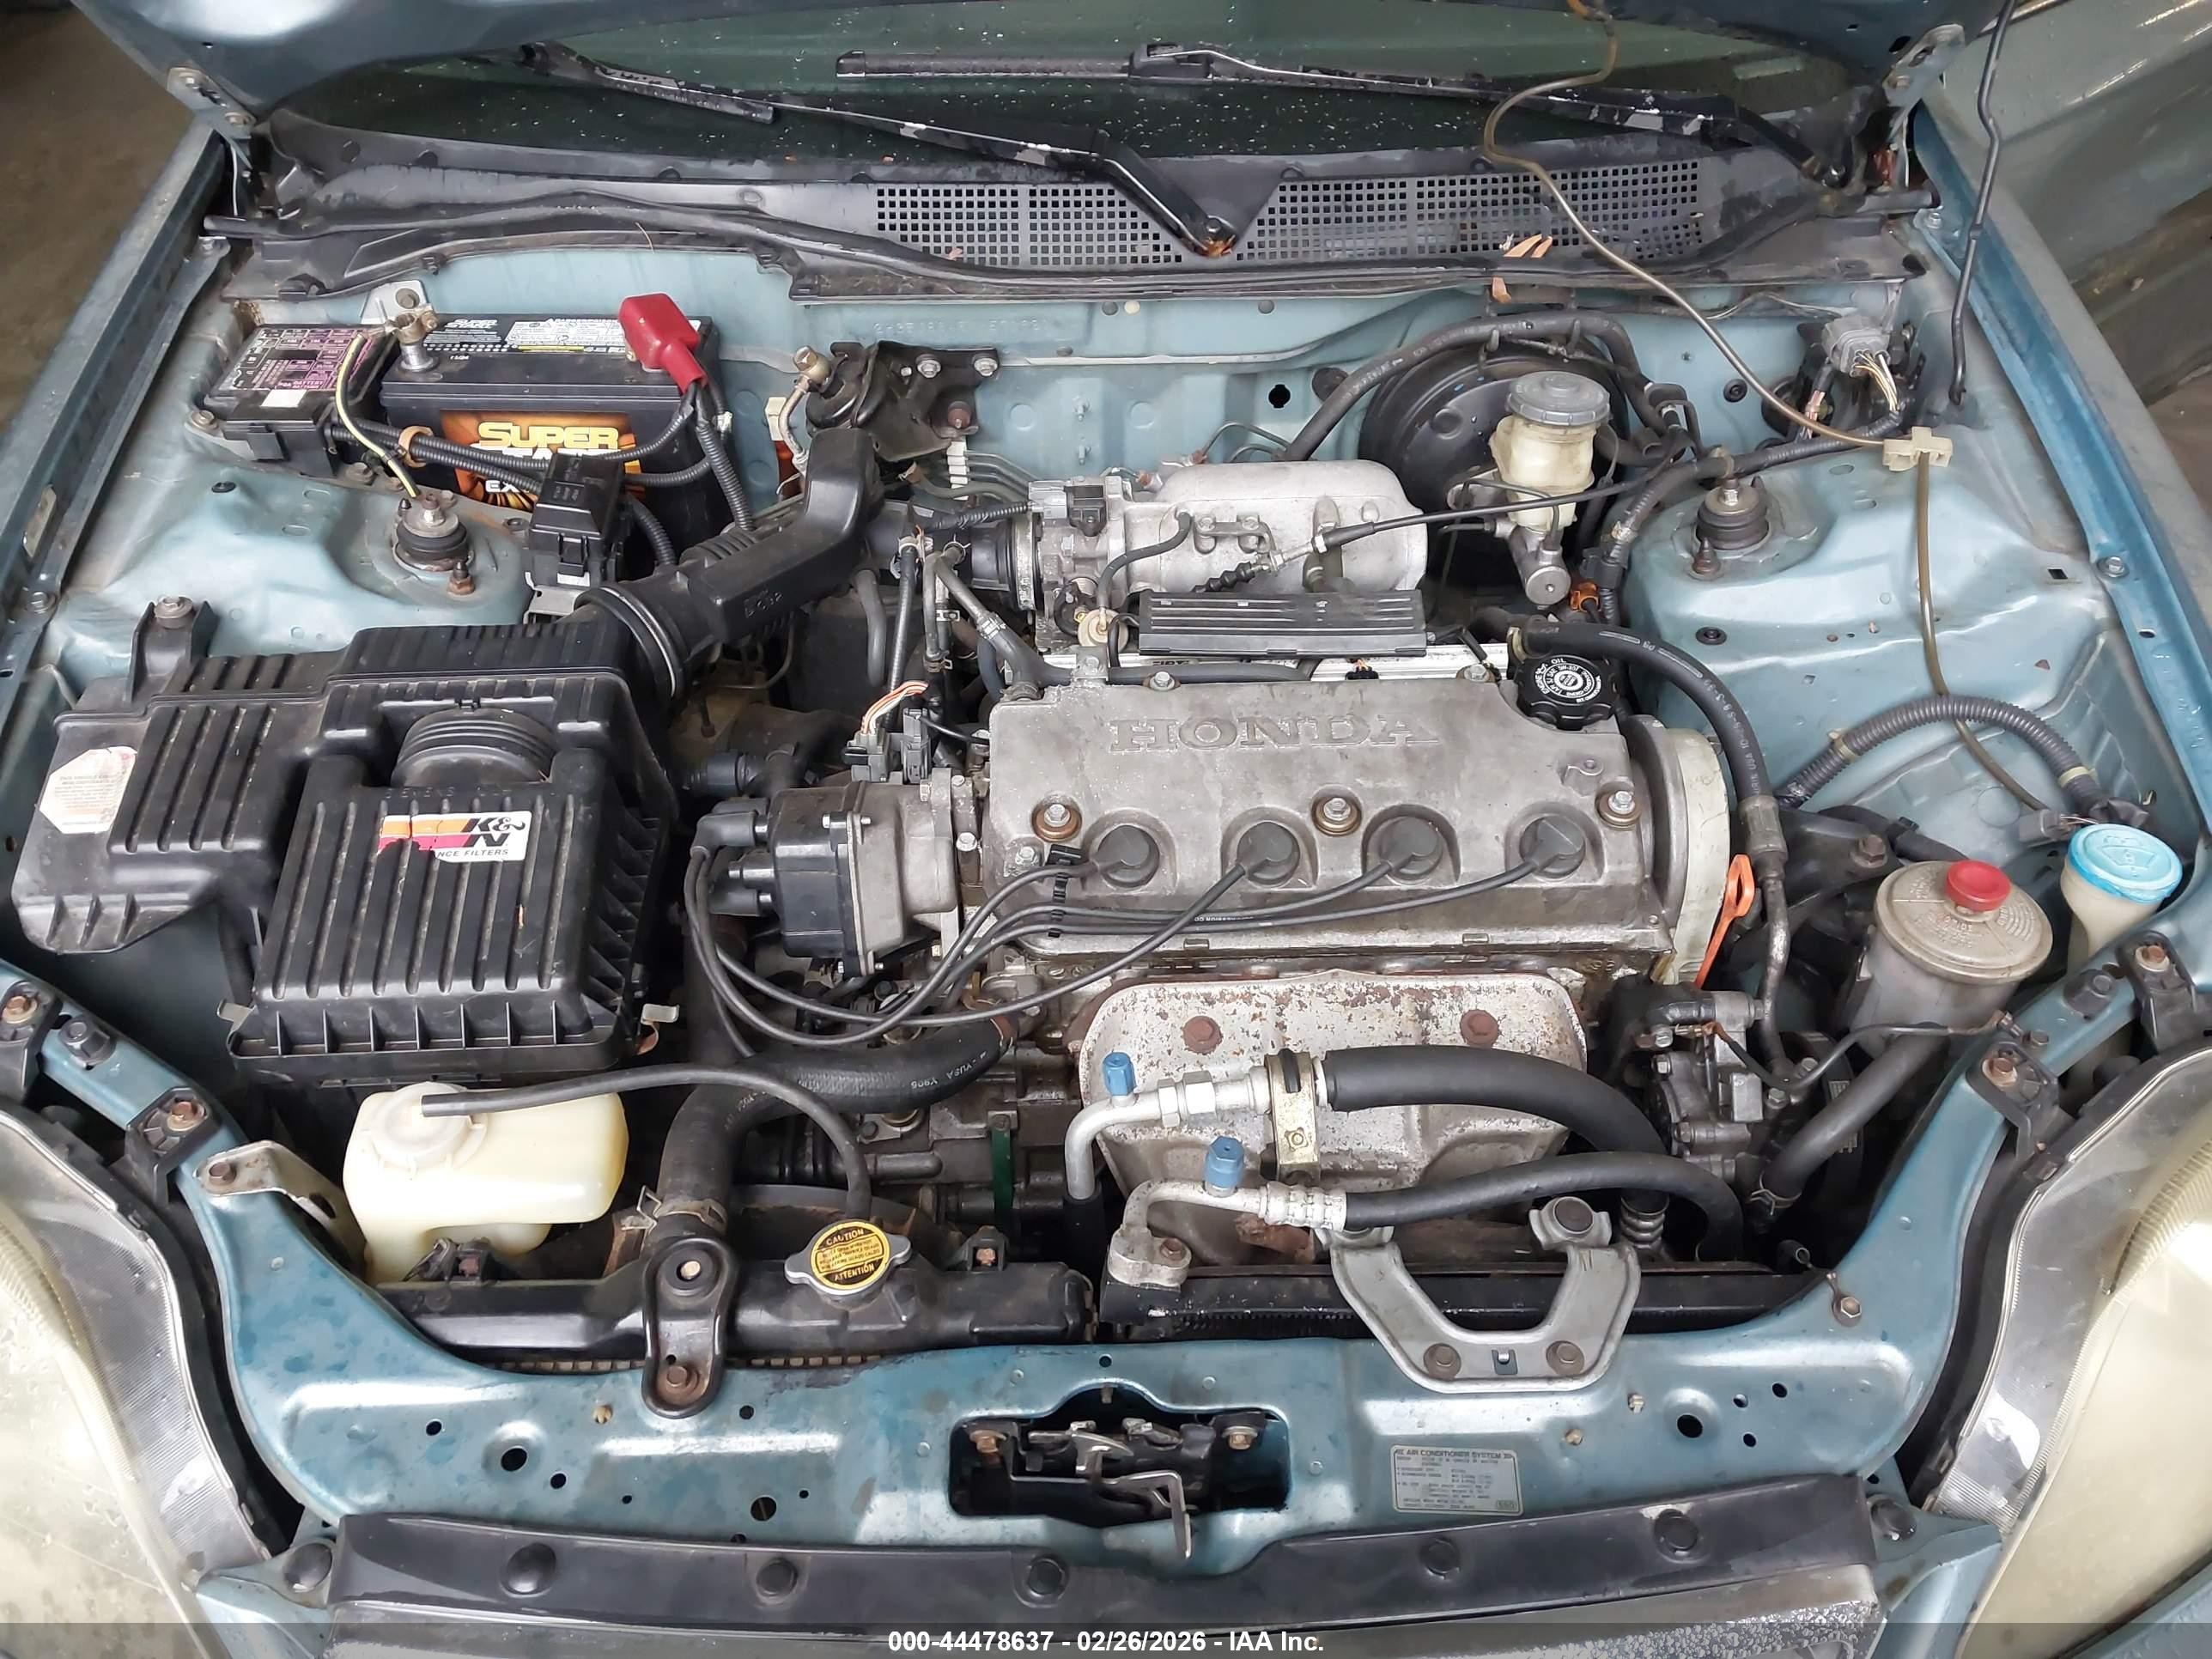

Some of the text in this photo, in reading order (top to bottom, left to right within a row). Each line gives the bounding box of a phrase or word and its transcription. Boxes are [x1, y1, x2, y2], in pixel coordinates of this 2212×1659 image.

[478, 422, 619, 450] SUPER
[1109, 714, 1439, 754] HONDA
[826, 1229, 865, 1246] CAUTION
